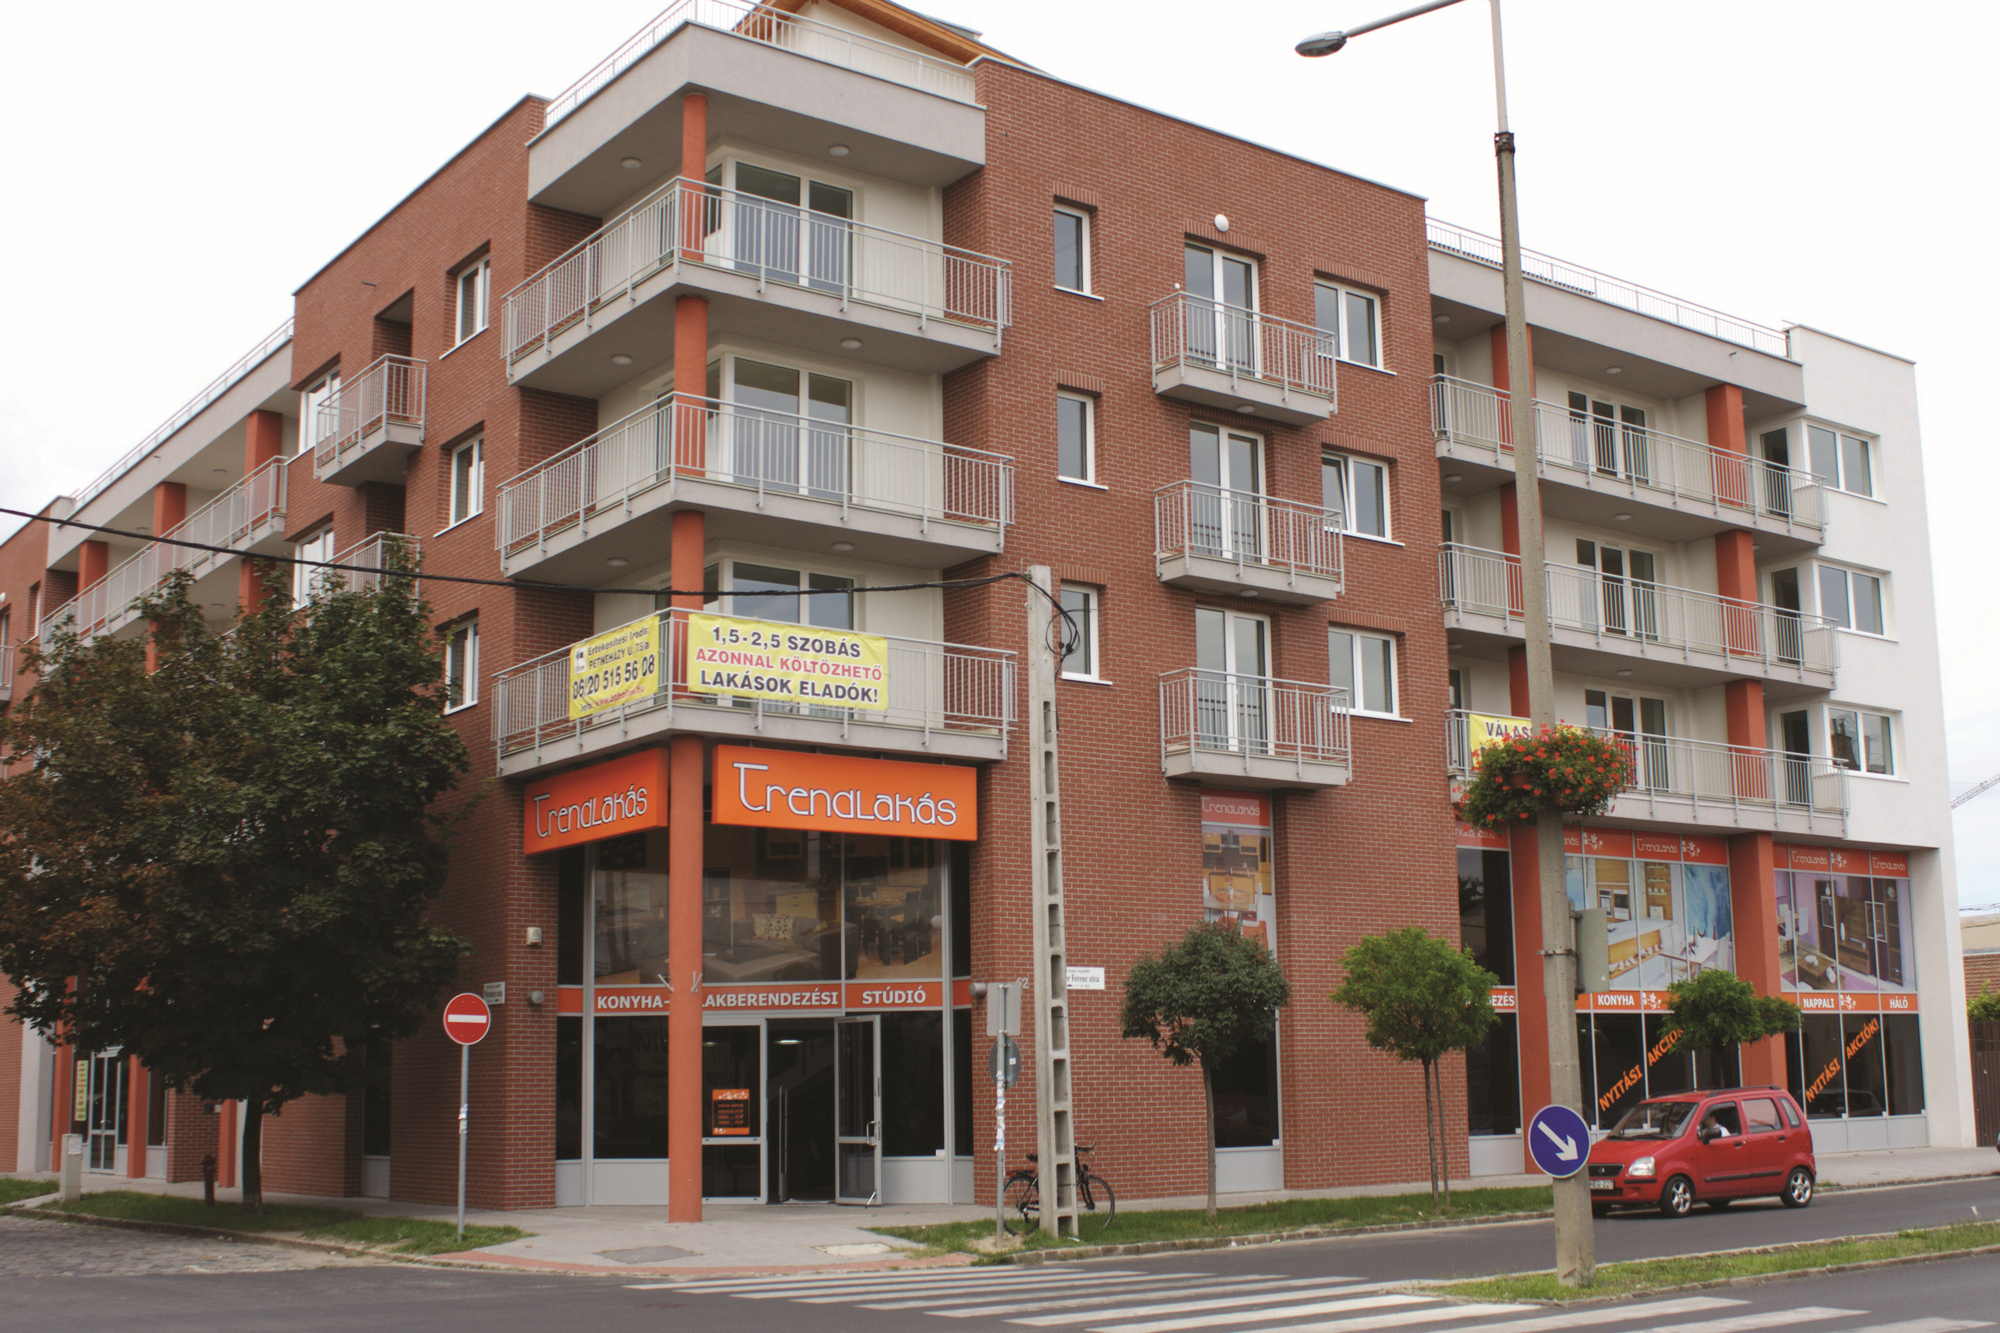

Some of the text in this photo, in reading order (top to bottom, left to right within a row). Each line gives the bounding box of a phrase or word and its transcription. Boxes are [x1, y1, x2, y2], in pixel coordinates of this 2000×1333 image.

[787, 635, 861, 658] SZOBÁS
[603, 666, 621, 690] 515
[624, 660, 638, 683] 56
[641, 654, 655, 677] 08
[695, 648, 882, 681] AZONNAL KÖLTÖZHETŐ
[701, 670, 878, 703] LAKÁSOK ELADÓK!
[1485, 719, 1532, 739] VÁLAS
[732, 762, 957, 826] TrendLakás
[533, 784, 648, 838] TrendLakás
[1071, 974, 1088, 983] Ferenc
[1088, 974, 1099, 983] utca
[702, 988, 838, 1008] AKBERENDEZÉSI
[861, 985, 926, 1005] STÚDIÓ
[1597, 994, 1635, 1006] KONYHA
[1803, 998, 1835, 1008] NAPPALI
[1889, 996, 1909, 1009] HÁLÓ
[1805, 1017, 1880, 1103] NYITÁSI AKCIÓK!
[1599, 1064, 1643, 1112] NYITÁSI
